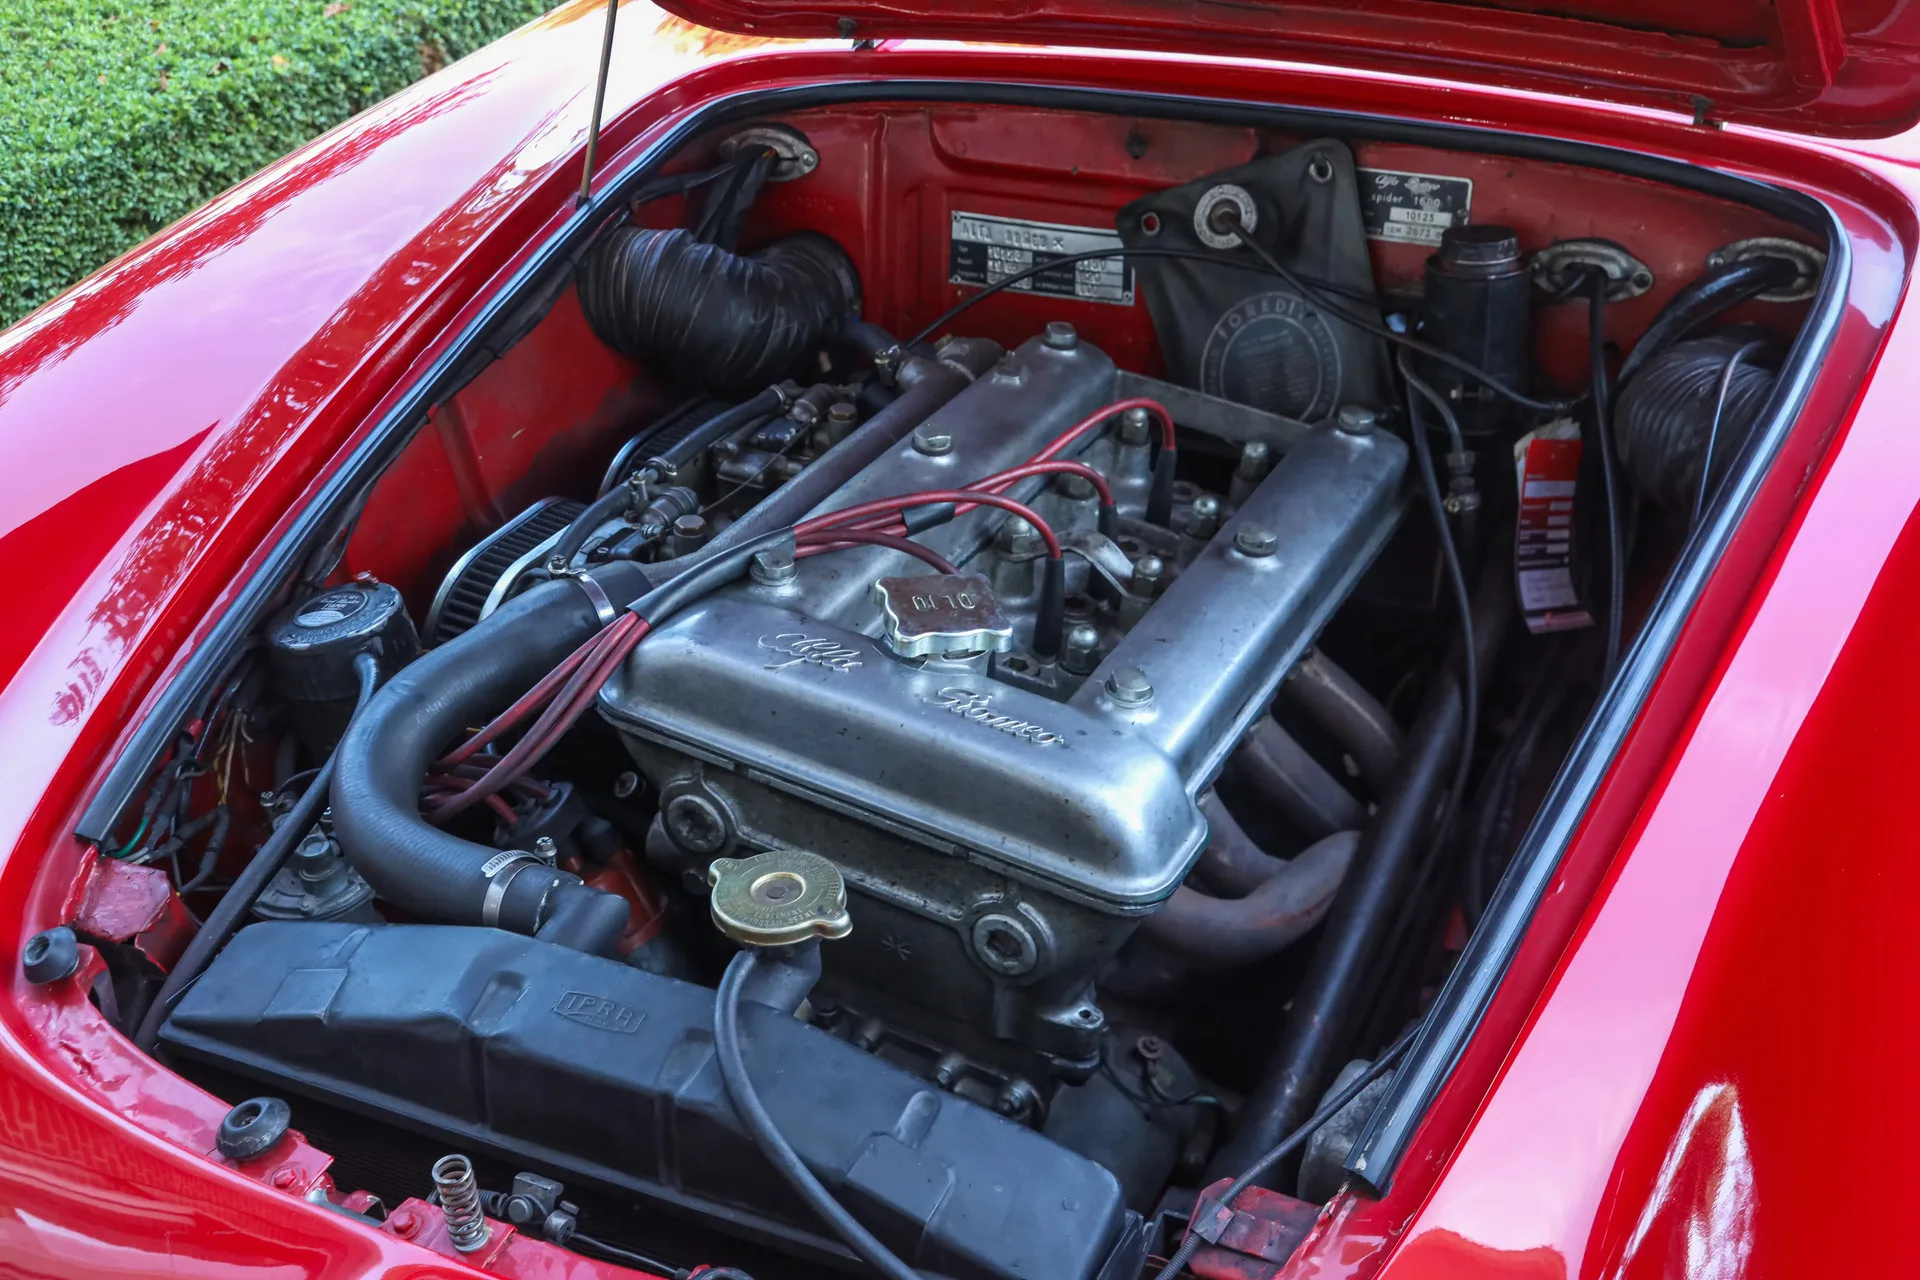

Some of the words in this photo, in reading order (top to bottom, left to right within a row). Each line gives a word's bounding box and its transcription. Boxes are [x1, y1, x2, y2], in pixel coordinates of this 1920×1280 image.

[1371, 192, 1403, 204] spider
[757, 632, 863, 673] Alfa
[922, 687, 1064, 745] Romeo
